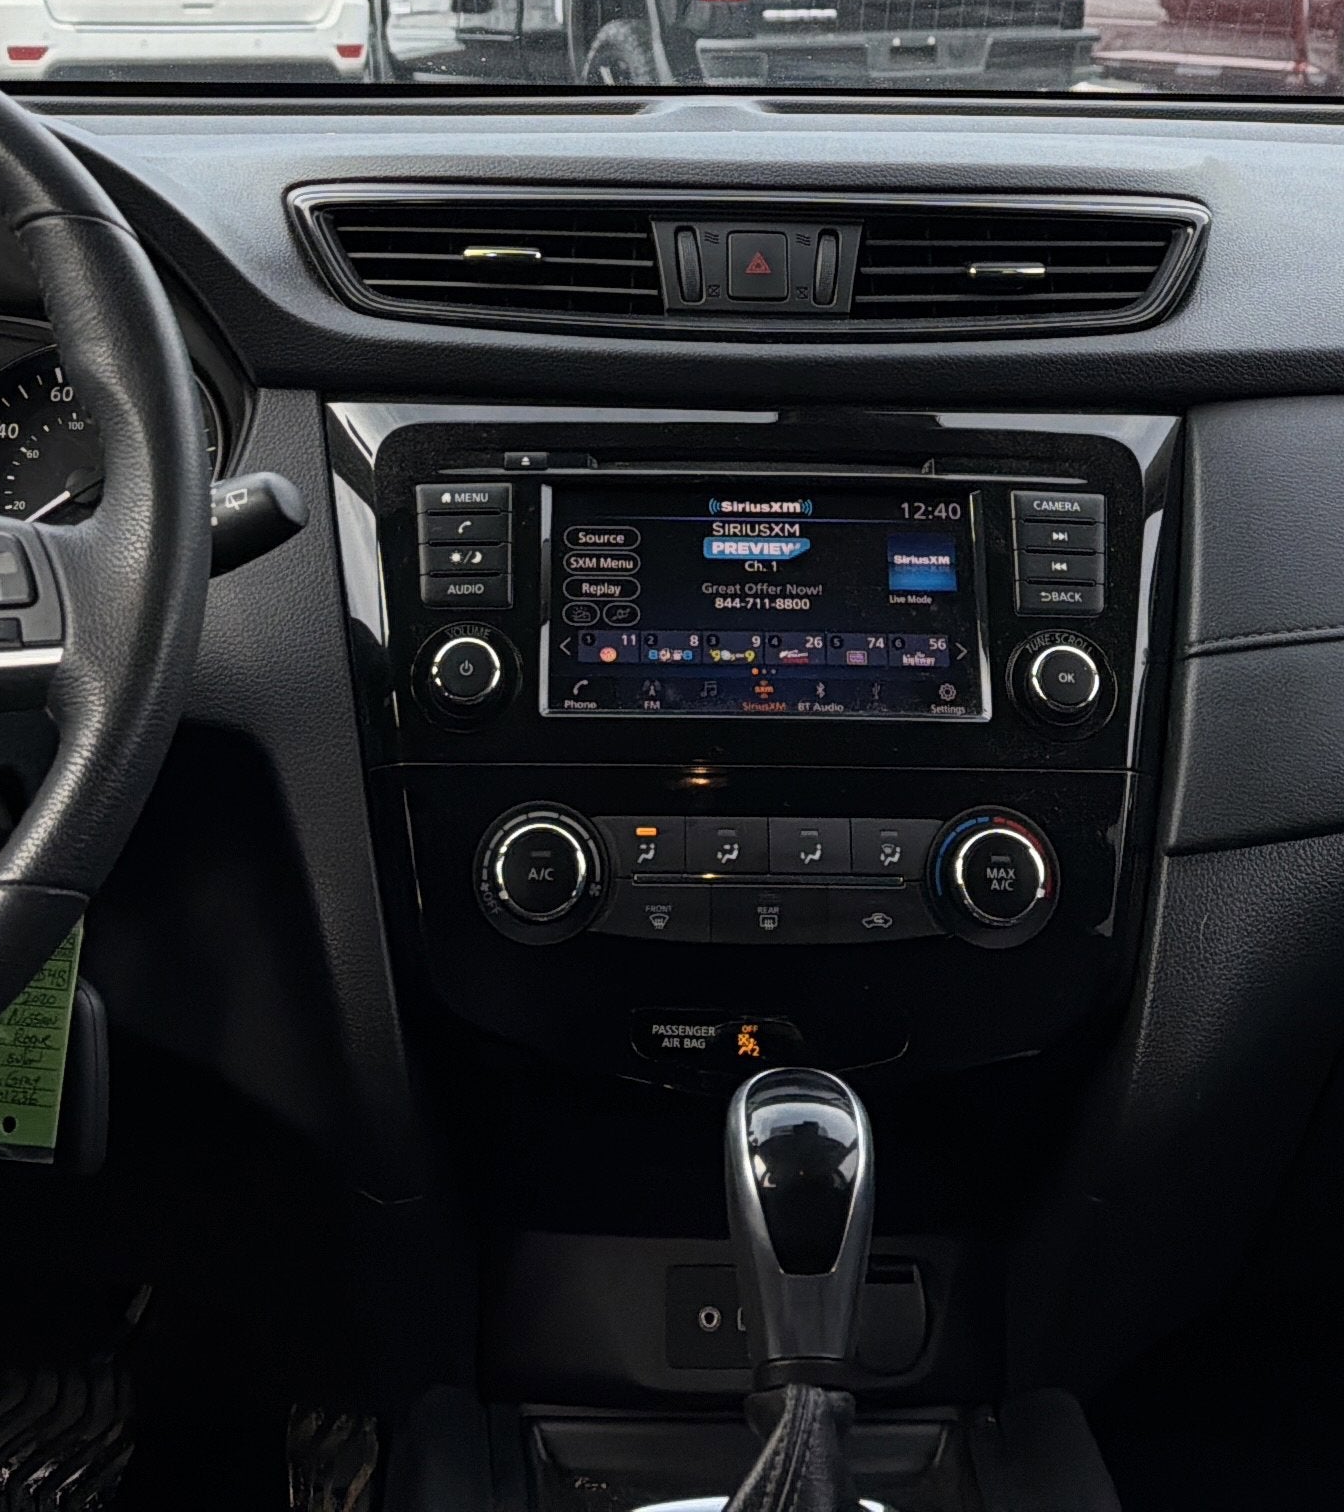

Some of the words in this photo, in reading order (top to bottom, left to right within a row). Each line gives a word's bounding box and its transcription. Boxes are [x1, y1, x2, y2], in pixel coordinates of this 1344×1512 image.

[50, 386, 74, 402] 60
[67, 421, 85, 431] 100
[454, 492, 489, 503] MENU
[12, 501, 26, 510] 20
[900, 502, 961, 520] 12:40
[1033, 500, 1081, 512] CAMERA
[712, 522, 800, 537] SIRIUSXM
[578, 531, 625, 544] Source
[711, 541, 801, 555] PREVIEW
[569, 557, 597, 569] SXM
[599, 557, 634, 569] Menu
[771, 561, 778, 573] 1
[447, 583, 485, 594] AUDIO
[581, 582, 621, 597] Replay
[701, 582, 741, 595] Great
[744, 582, 783, 595] Offer
[785, 584, 823, 596] Now!
[889, 594, 908, 605] Live
[910, 594, 933, 605] Mode
[1052, 591, 1082, 603] BACK
[714, 598, 811, 610] 844-711-8800
[444, 625, 492, 640] VOLUME
[621, 634, 637, 646] 11
[689, 635, 698, 646] 8
[751, 635, 761, 647] 9
[805, 636, 823, 648] 26
[867, 637, 885, 648] 74
[928, 638, 947, 650] 56
[1058, 672, 1075, 684] OK
[563, 699, 597, 709] Phone
[644, 700, 660, 709] FM
[812, 702, 845, 712] Audio
[930, 704, 966, 715] Settings
[527, 867, 555, 881] A/C
[986, 867, 1016, 879] MAX
[990, 880, 1015, 891] A/C
[645, 904, 672, 912] FRONT
[757, 906, 780, 914] REAR
[652, 1024, 716, 1037] PASSENGER
[741, 1024, 759, 1033] OFF
[661, 1038, 681, 1048] AIR
[683, 1038, 706, 1049] BAG
